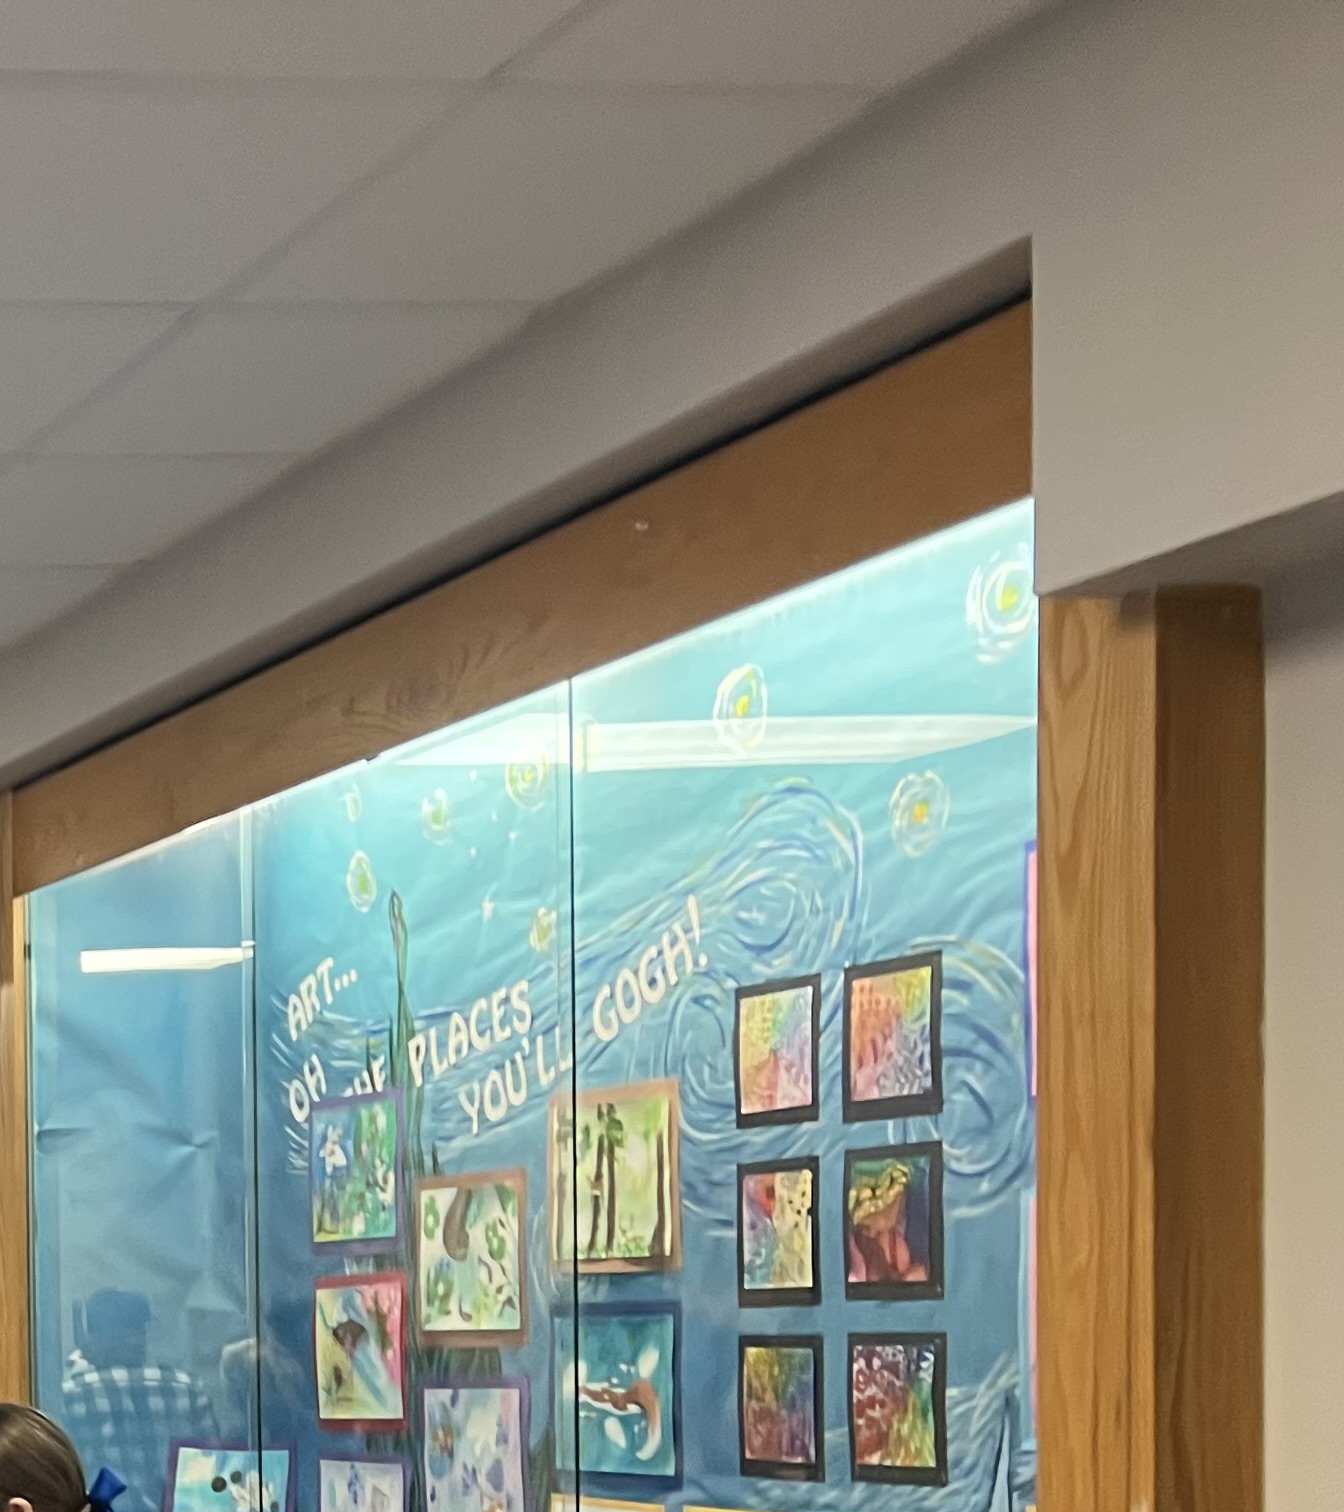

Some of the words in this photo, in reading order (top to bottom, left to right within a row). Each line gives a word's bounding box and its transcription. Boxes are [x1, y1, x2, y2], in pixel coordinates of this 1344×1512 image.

[288, 957, 358, 1043] ART...
[288, 1053, 327, 1123] OH
[408, 979, 532, 1088] PLACES
[457, 1026, 574, 1136] YOU'LL
[592, 893, 708, 1042] GOGH!
